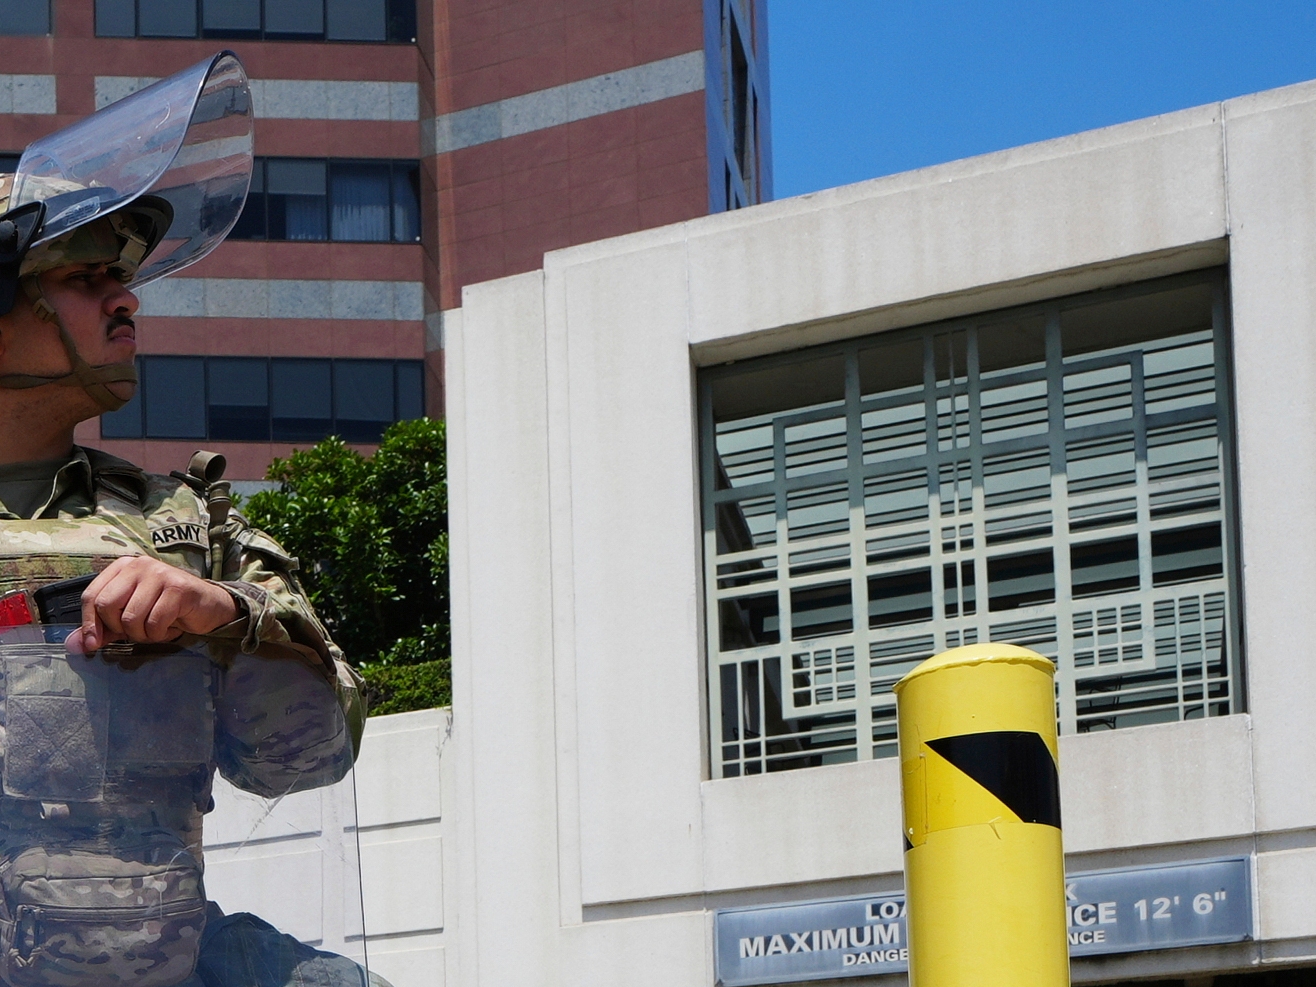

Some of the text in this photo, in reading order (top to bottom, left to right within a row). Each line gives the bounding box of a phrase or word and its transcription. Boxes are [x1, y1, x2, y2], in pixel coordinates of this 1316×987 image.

[152, 525, 200, 545] ARMY
[739, 922, 899, 959] MAXIMUM
[1134, 895, 1180, 921] 12'
[1192, 891, 1226, 915] 6"
[843, 947, 908, 966] DANGE
